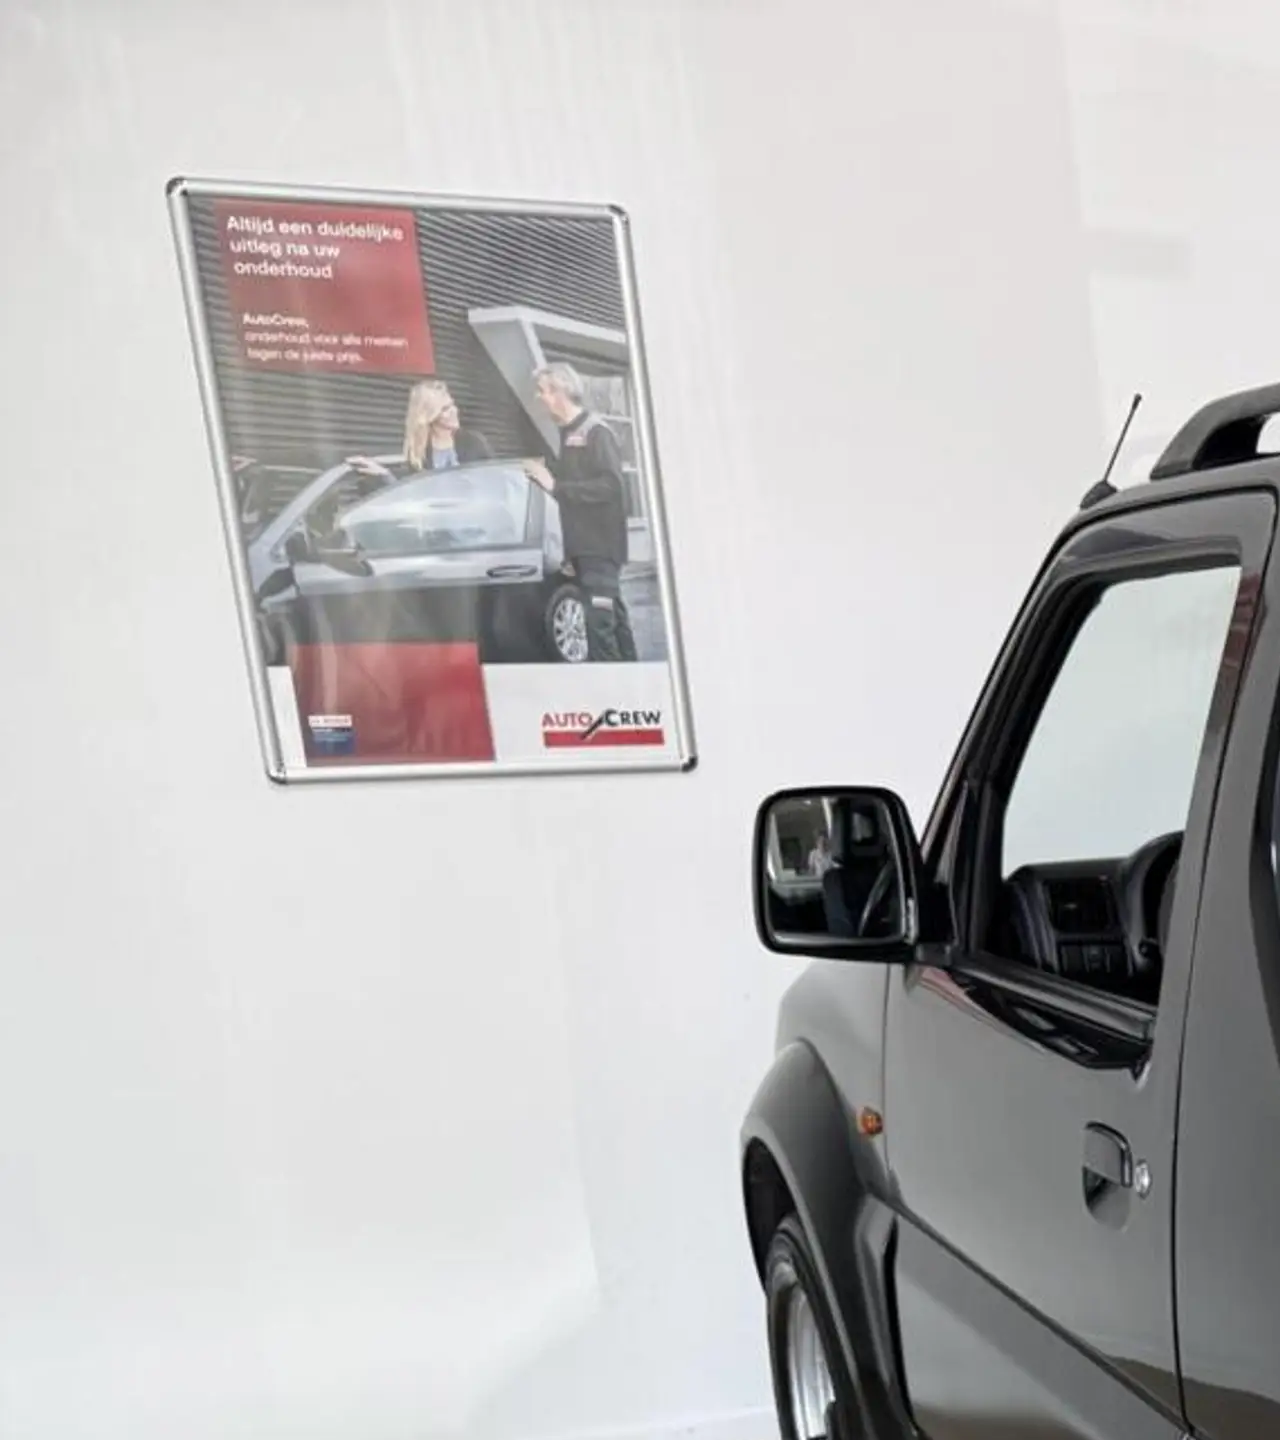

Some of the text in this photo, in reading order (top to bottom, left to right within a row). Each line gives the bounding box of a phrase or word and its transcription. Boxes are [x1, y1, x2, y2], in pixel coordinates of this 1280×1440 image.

[226, 216, 404, 242] Altijd een duidelijke
[229, 238, 341, 258] uitleg na uw
[233, 261, 333, 279] onderhoud
[541, 709, 662, 727] AUTO CREW
